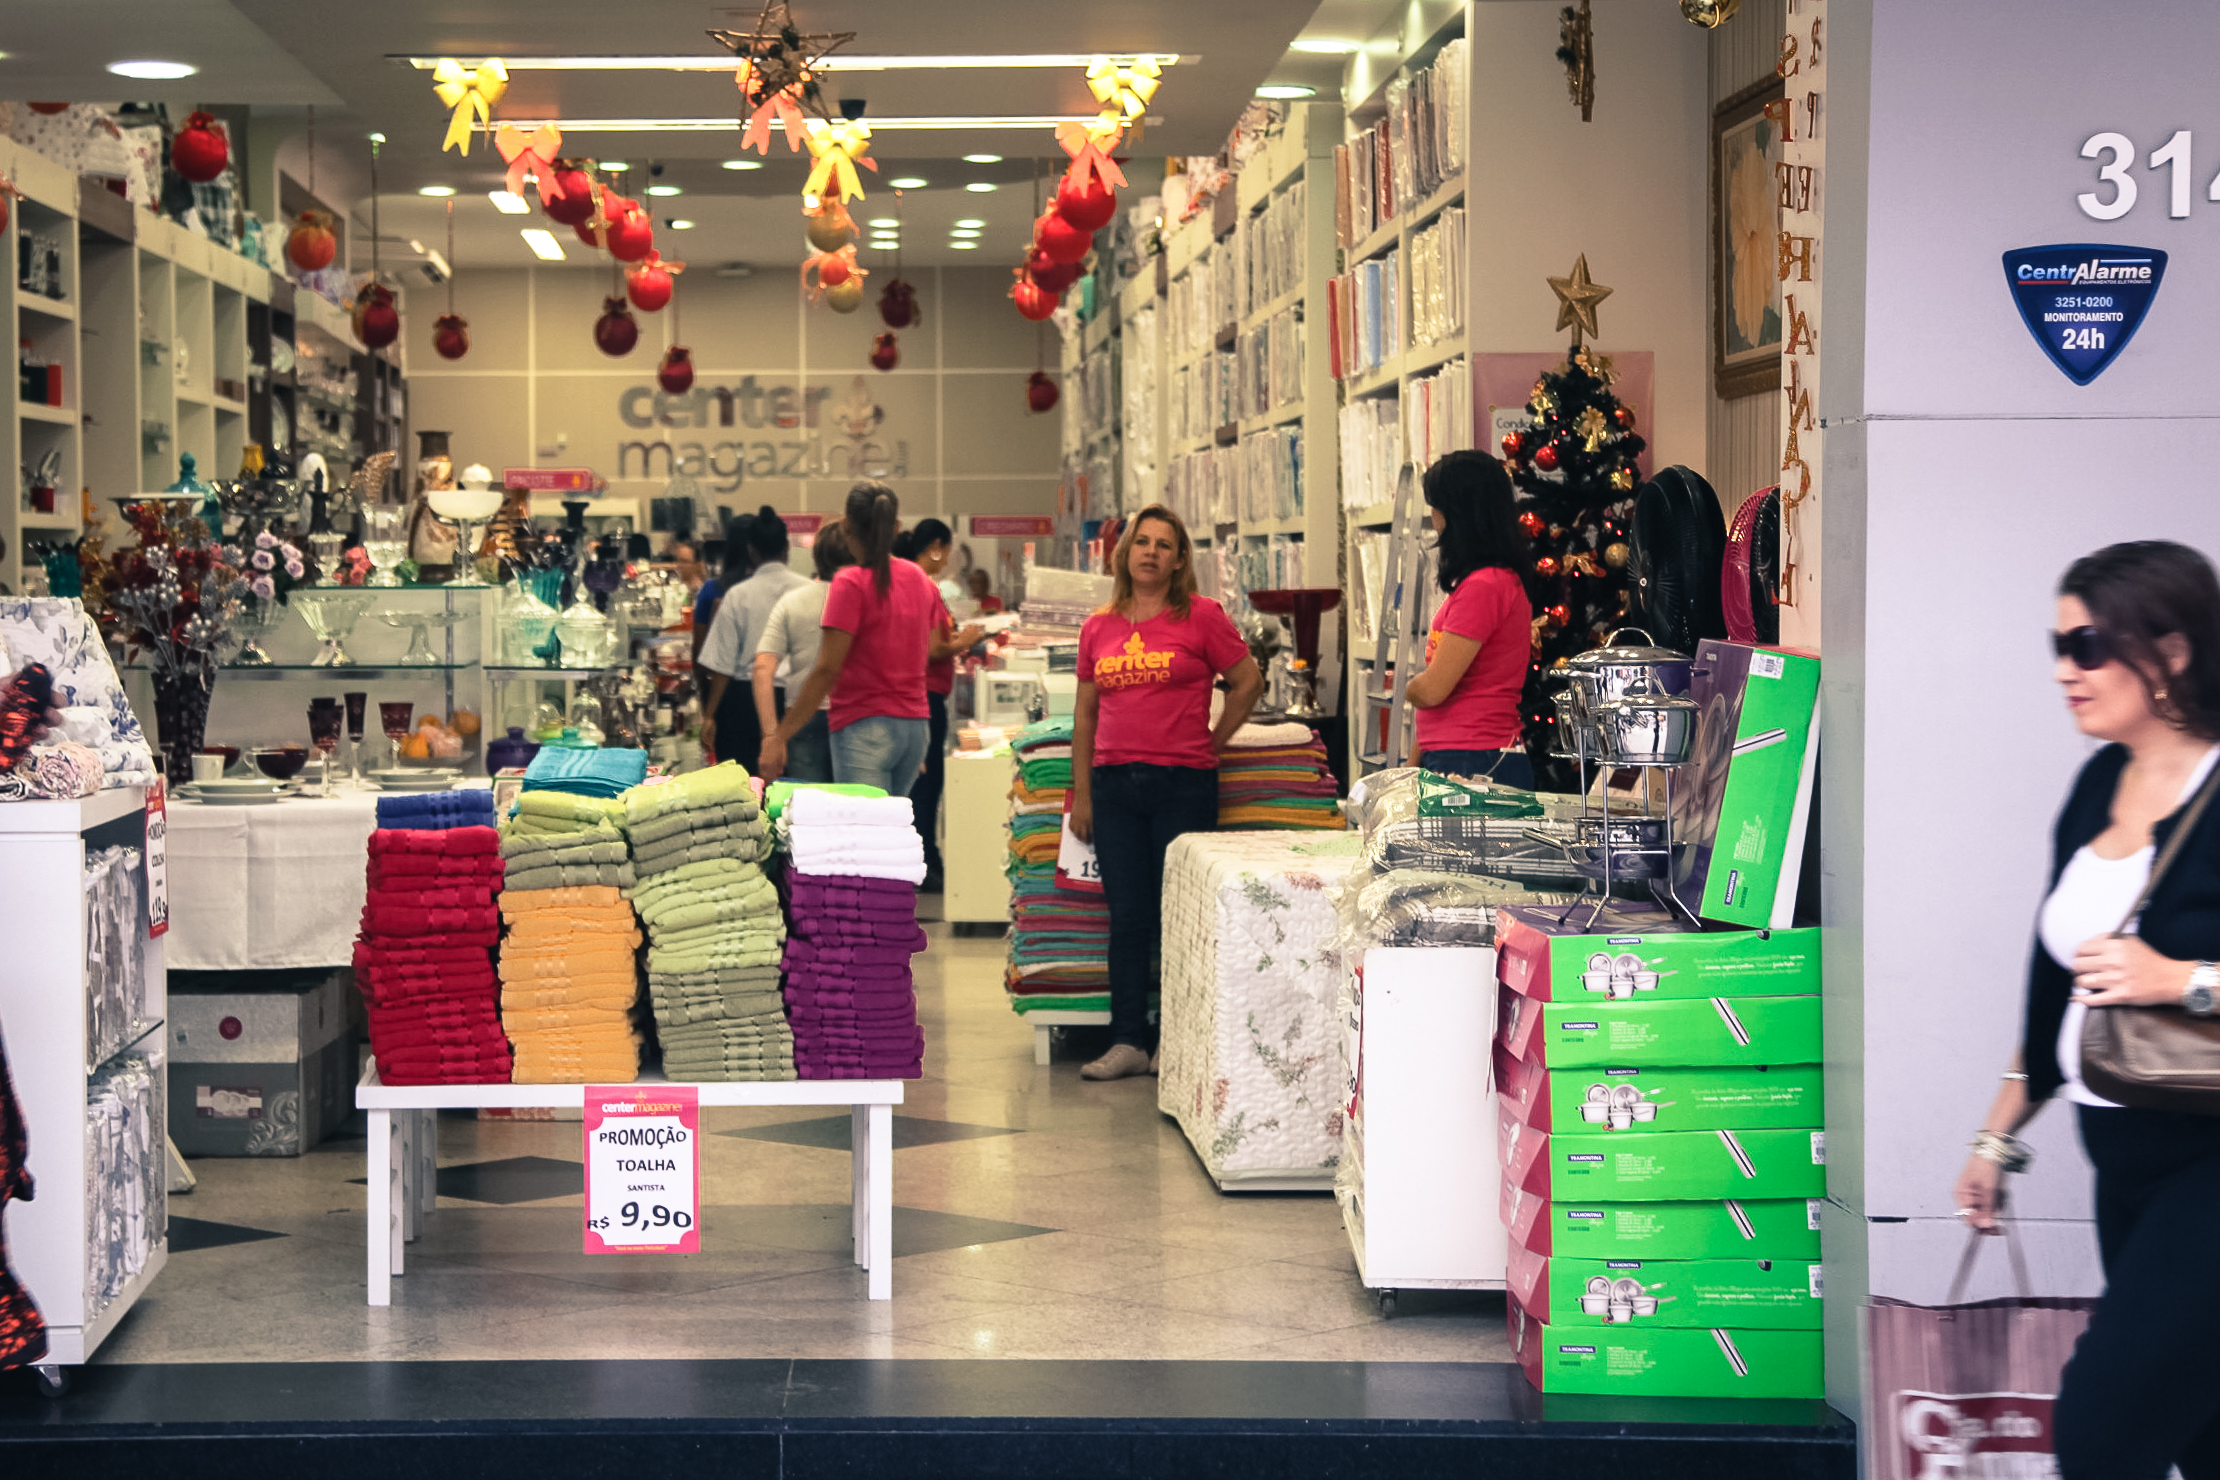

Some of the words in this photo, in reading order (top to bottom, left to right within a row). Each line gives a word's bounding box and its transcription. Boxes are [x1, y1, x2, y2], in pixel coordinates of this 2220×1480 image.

[2017, 259, 2152, 285] CentrAlarme
[2055, 297, 2113, 307] 3251-0200
[2044, 312, 2124, 322] MONITORAMENTO
[2062, 328, 2105, 350] 24h
[618, 375, 831, 429] center
[599, 1126, 687, 1149] PROMOÇÃO
[616, 1159, 676, 1171] TOALHA
[627, 1184, 665, 1192] SANTISTA
[587, 1216, 610, 1229] R$
[621, 1201, 692, 1231] 9,90
